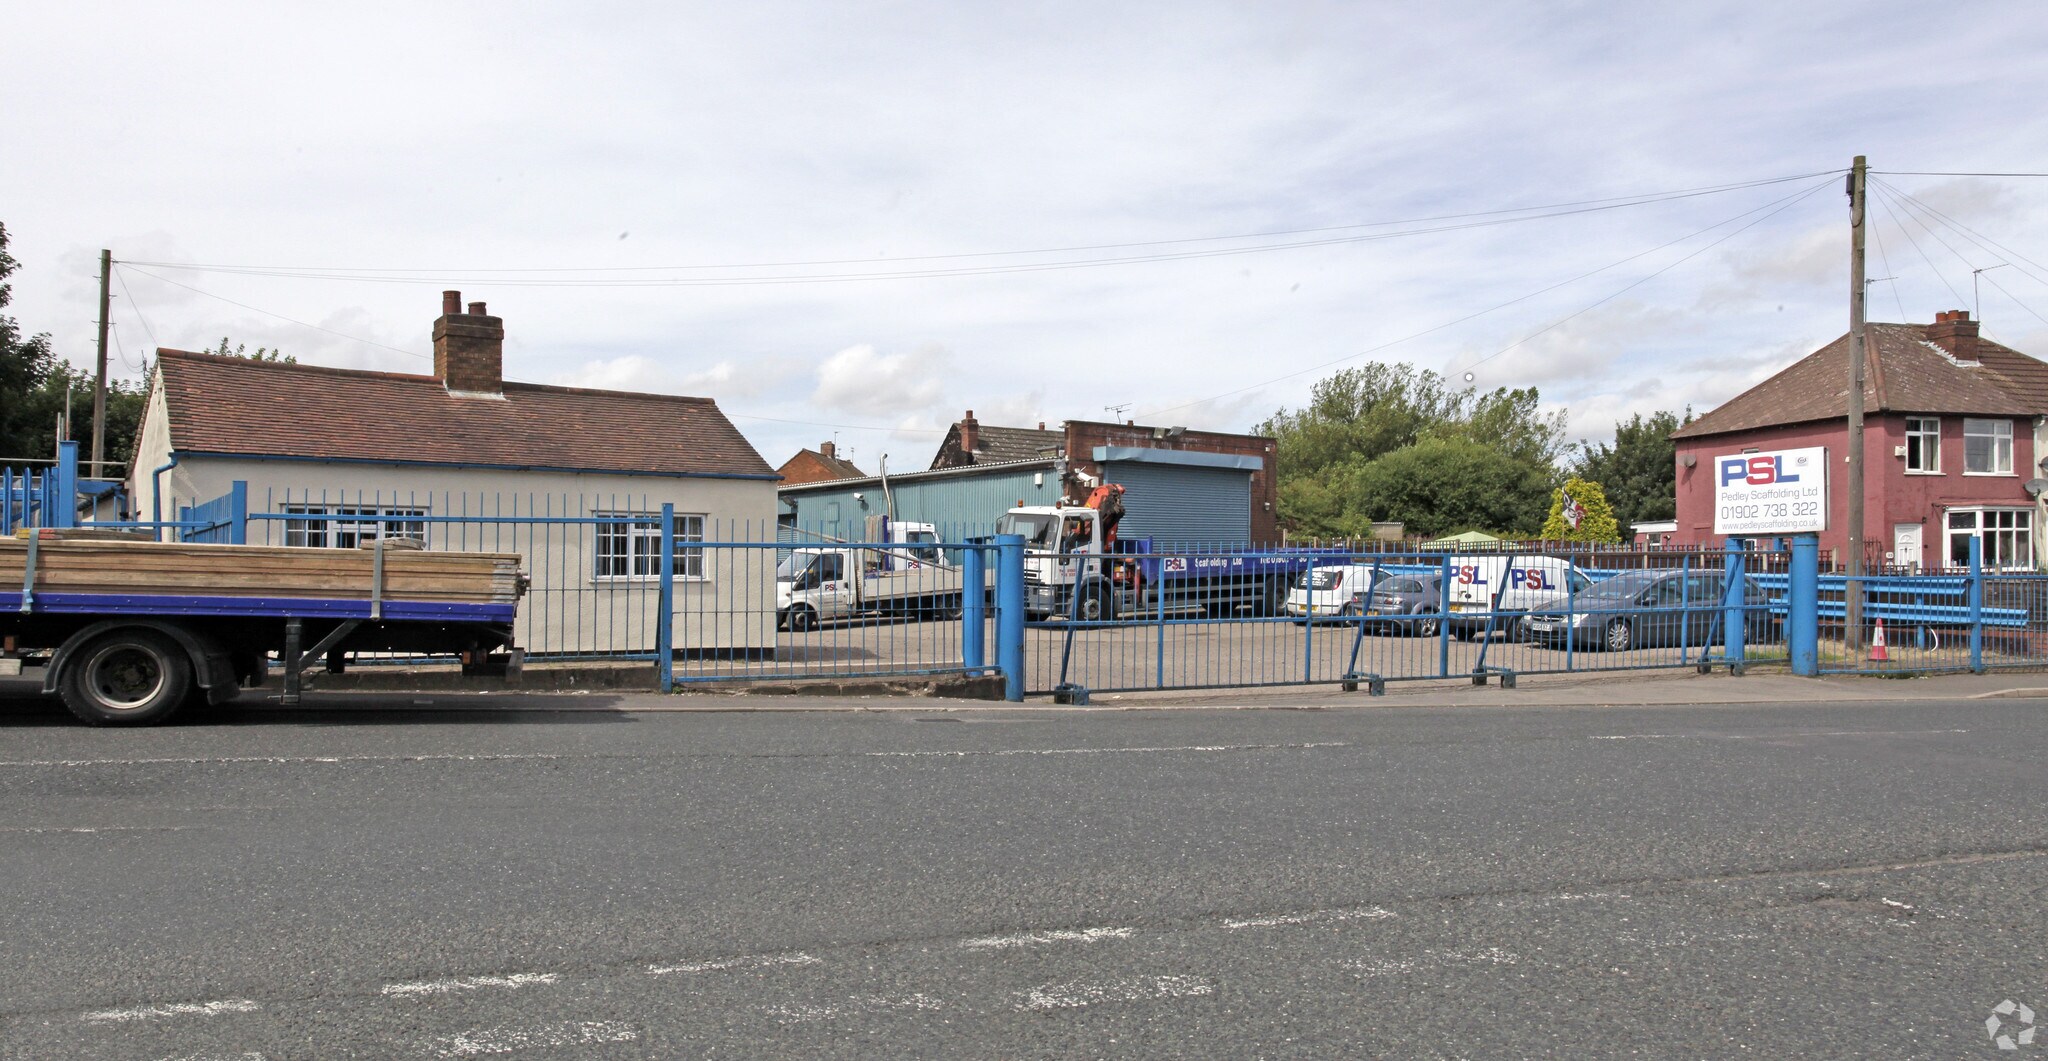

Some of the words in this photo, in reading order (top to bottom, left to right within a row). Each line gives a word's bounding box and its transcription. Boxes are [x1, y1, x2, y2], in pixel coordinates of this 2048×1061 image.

[1721, 455, 1800, 487] PSL
[1721, 492, 1749, 502] Pedley
[1751, 489, 1800, 500] Scaffolding
[1802, 486, 1818, 497] Ltd
[1721, 505, 1759, 519] 01902
[1763, 503, 1788, 517] 738
[1792, 501, 1818, 516] 322
[1721, 518, 1818, 530] www.pedleyscaffolding.co.uk
[1165, 558, 1185, 570] PSL
[1448, 565, 1488, 585] PSL
[1511, 568, 1556, 590] PSL
[824, 583, 838, 591] PS
